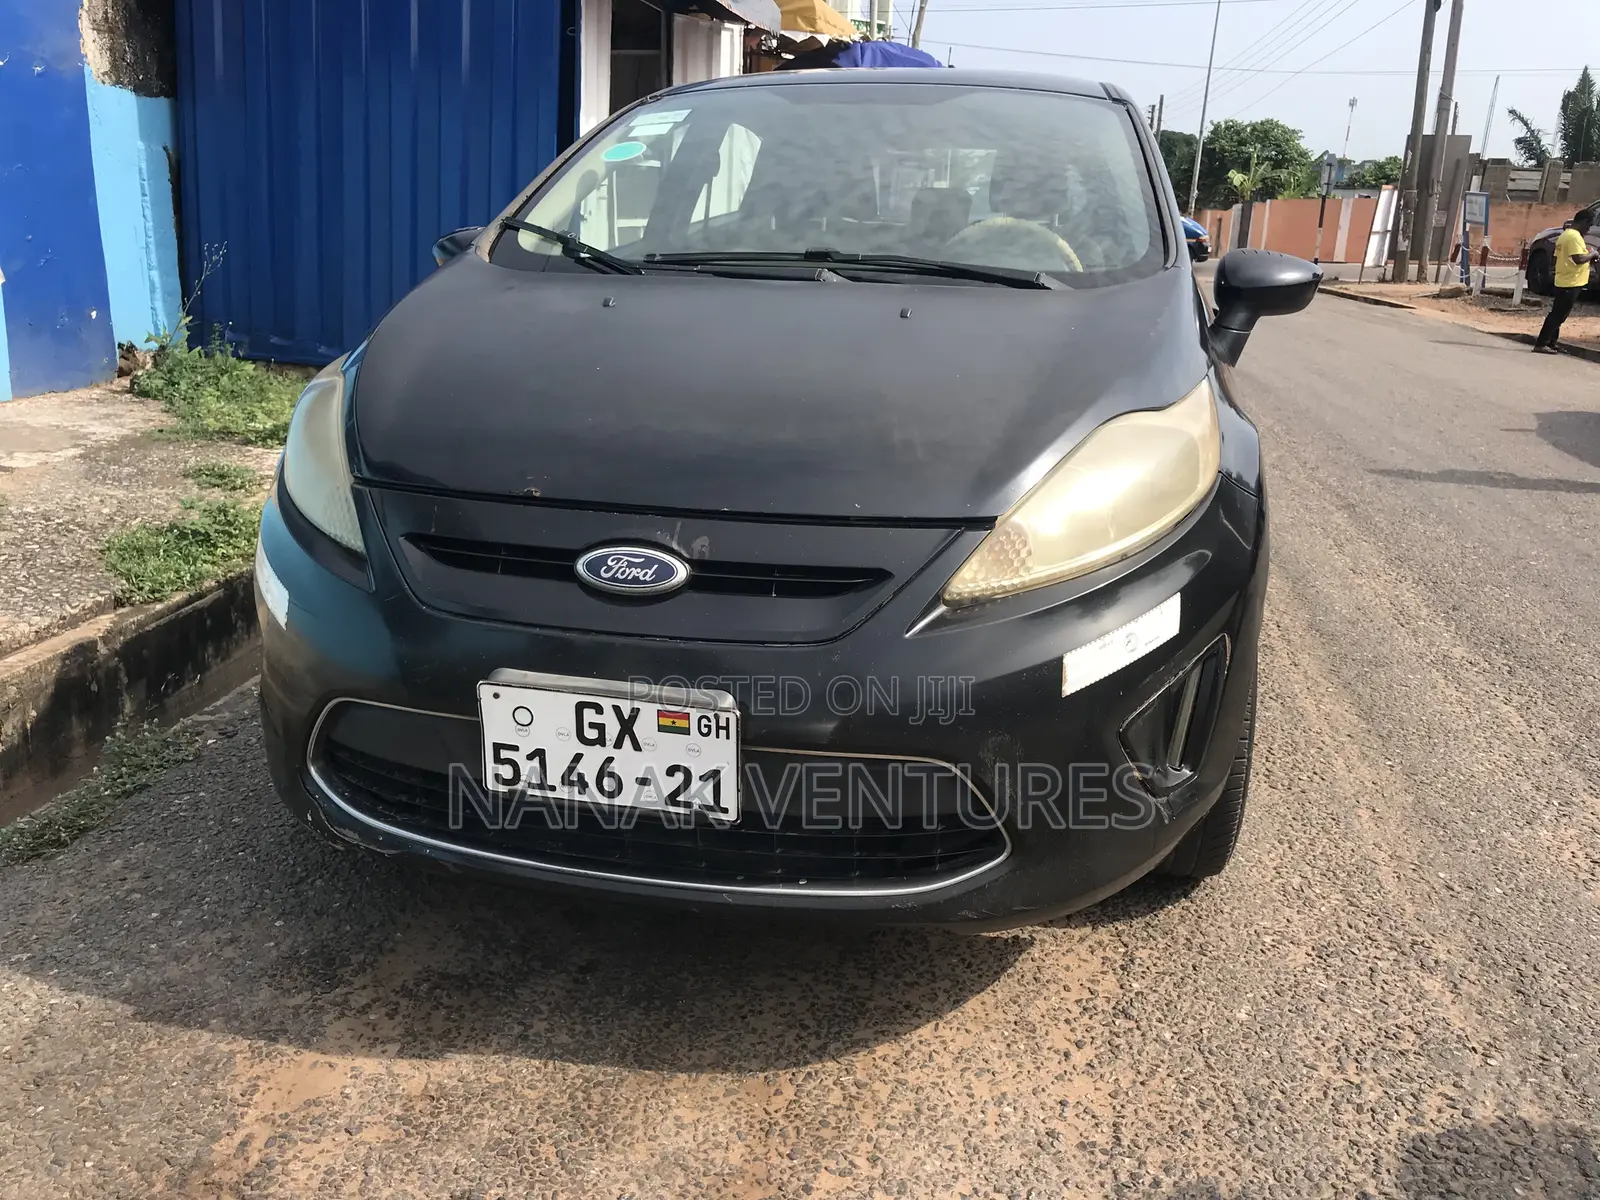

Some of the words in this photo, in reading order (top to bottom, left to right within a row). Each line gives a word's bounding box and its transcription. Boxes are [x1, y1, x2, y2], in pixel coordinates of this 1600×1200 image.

[600, 555, 658, 581] Ford
[575, 700, 642, 752] GX
[698, 714, 730, 740] GH
[492, 741, 729, 815] 5146-21
